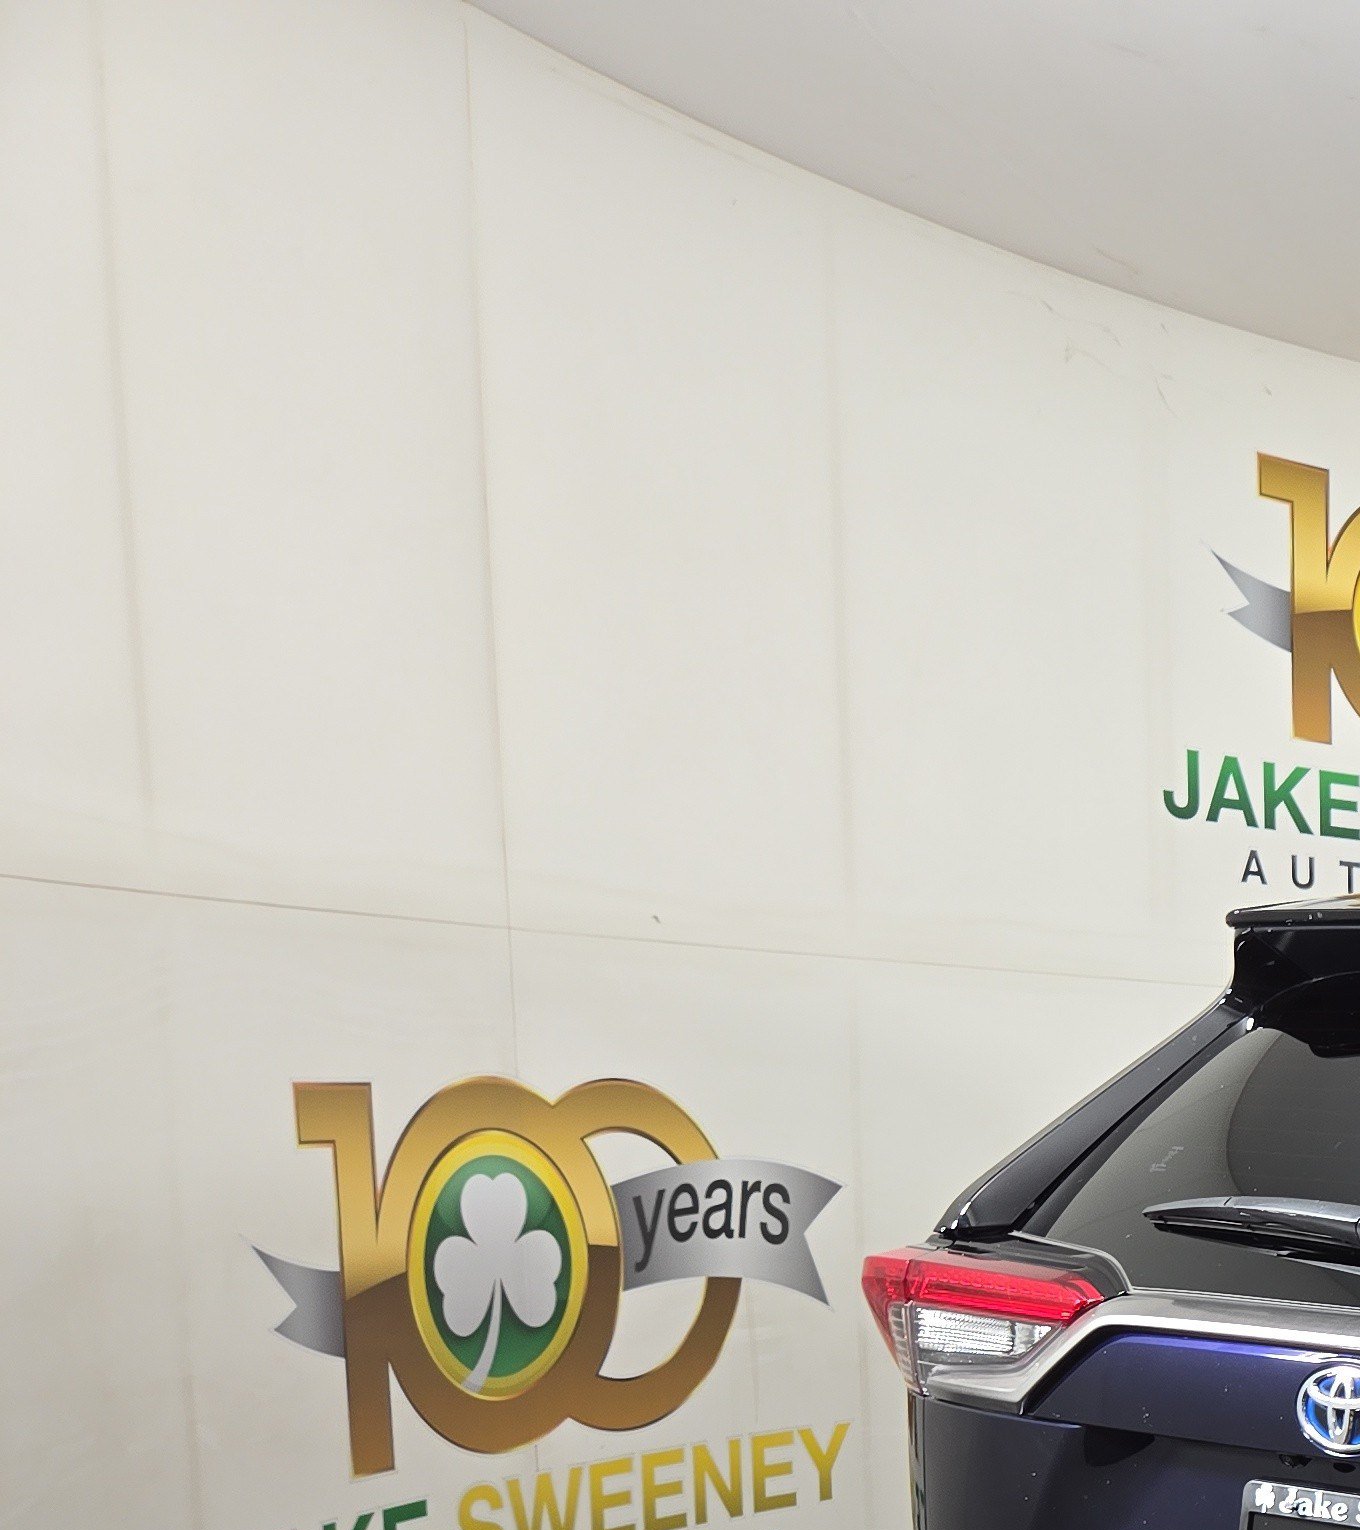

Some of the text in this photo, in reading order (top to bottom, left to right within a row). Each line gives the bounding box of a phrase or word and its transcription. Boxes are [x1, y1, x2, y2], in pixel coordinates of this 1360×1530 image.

[1163, 749, 1360, 840] JAKE
[632, 1178, 790, 1272] years
[1279, 1488, 1348, 1521] Jake
